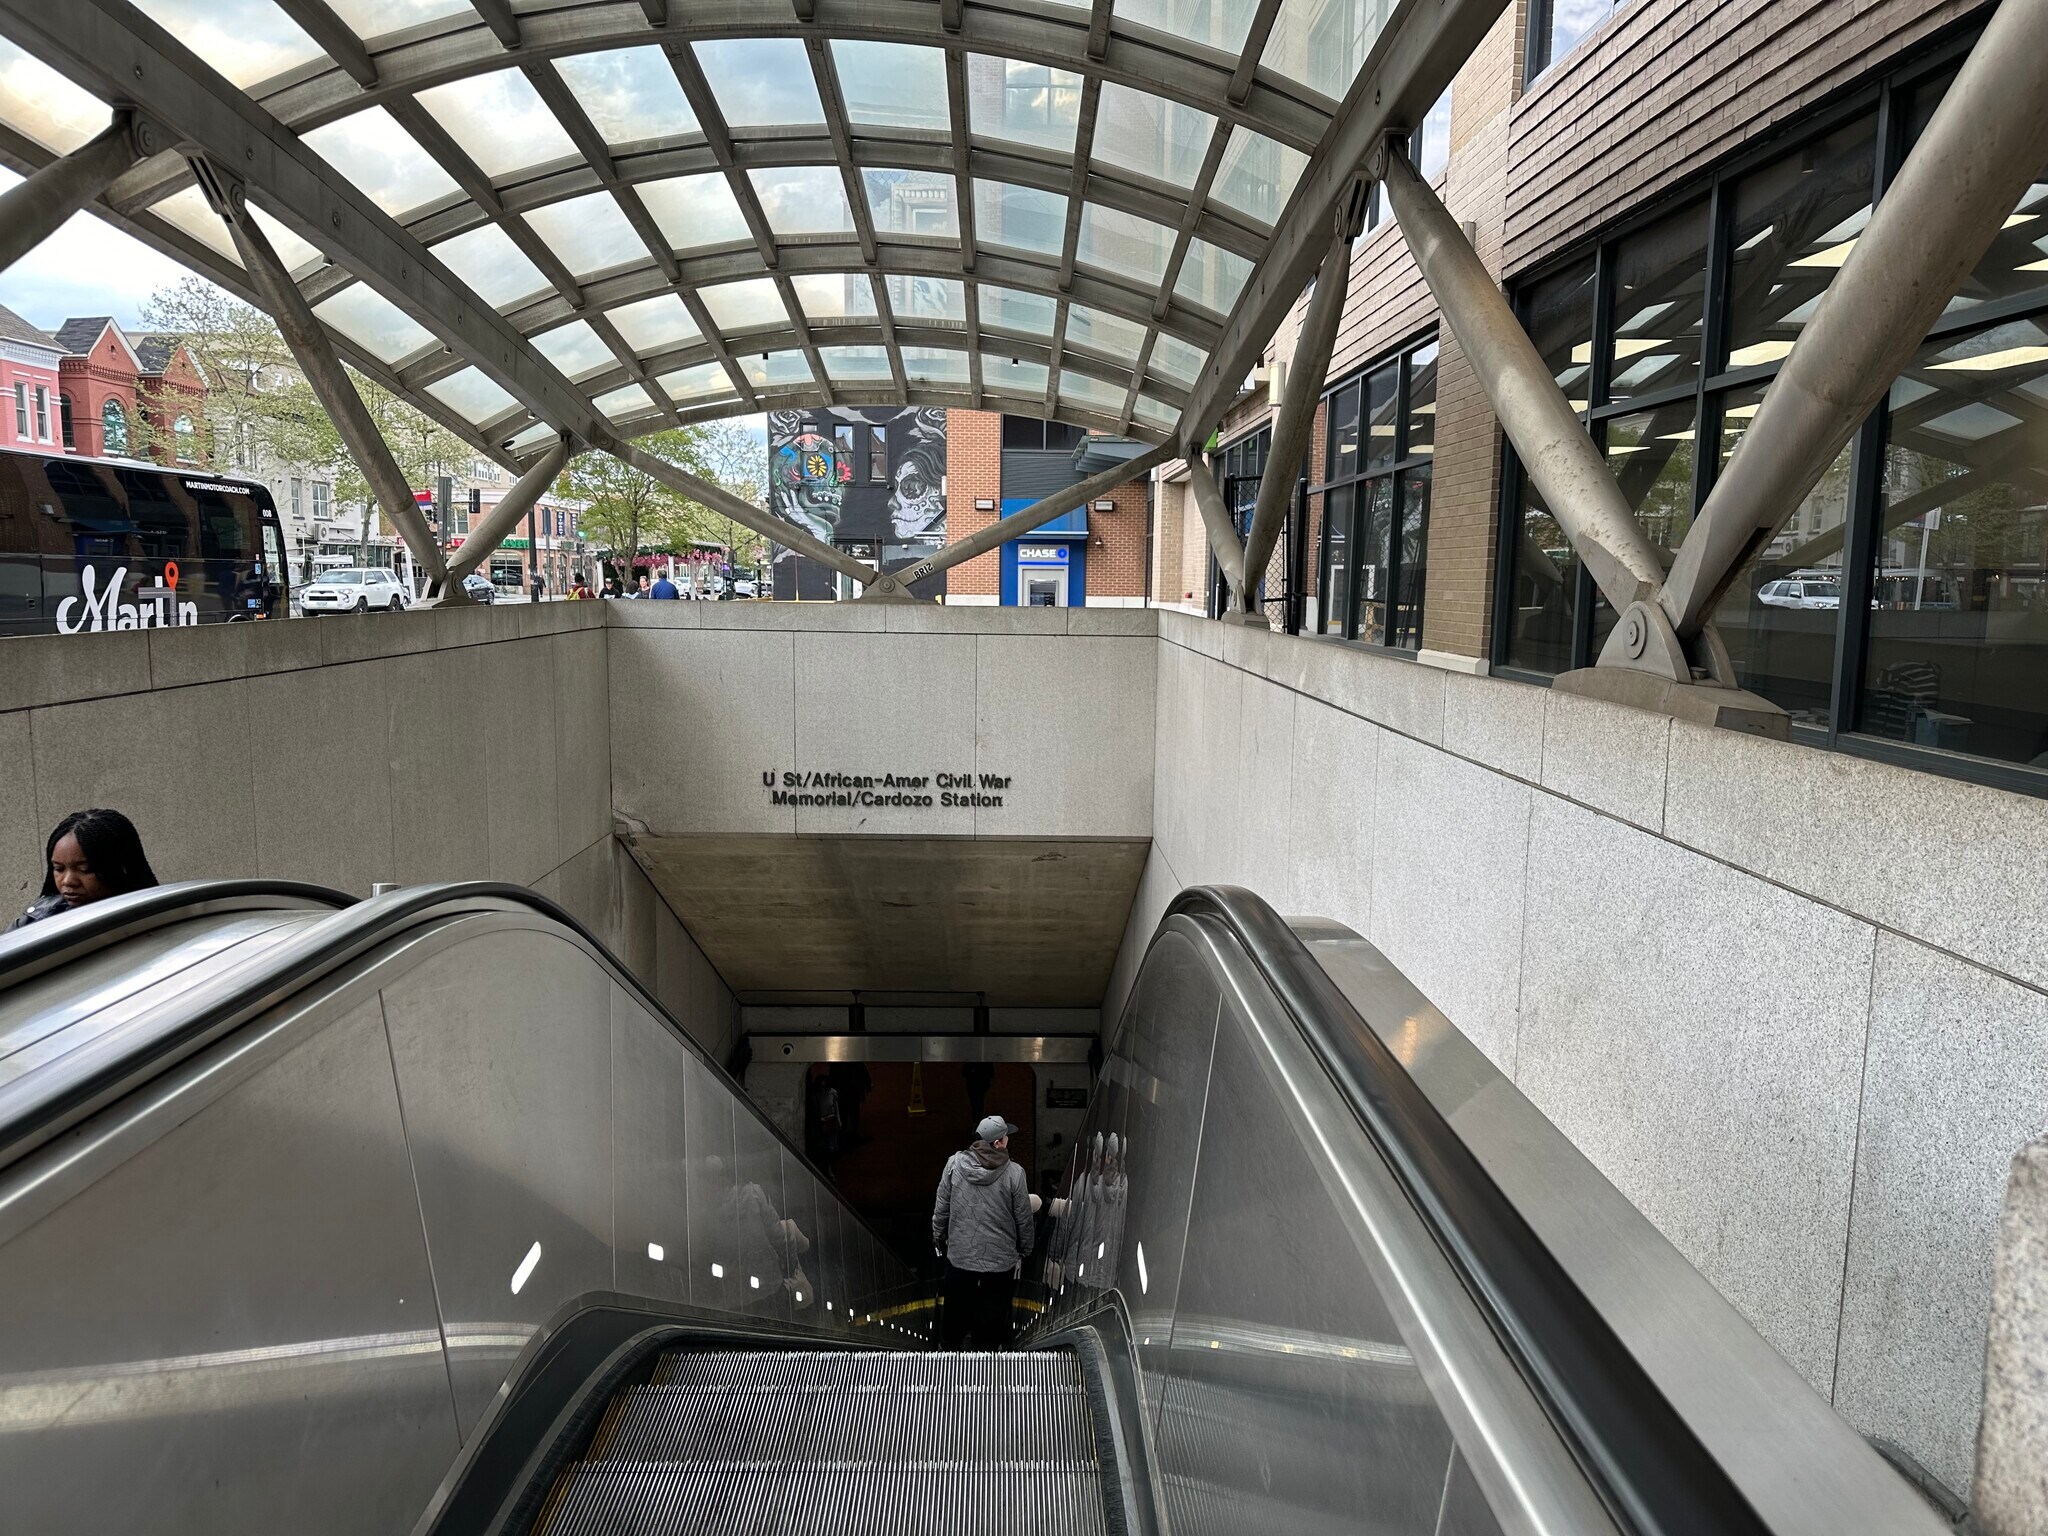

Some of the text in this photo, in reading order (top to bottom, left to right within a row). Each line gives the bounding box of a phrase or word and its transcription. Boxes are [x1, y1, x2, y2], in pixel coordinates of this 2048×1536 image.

[185, 480, 250, 495] MARTINMOTORCOACH.COM
[1020, 548, 1057, 559] CHASE
[56, 562, 198, 634] Martin
[762, 771, 1012, 789] U St/African-Amer Civil War
[772, 790, 1004, 807] Memorial/Cardozo Station
